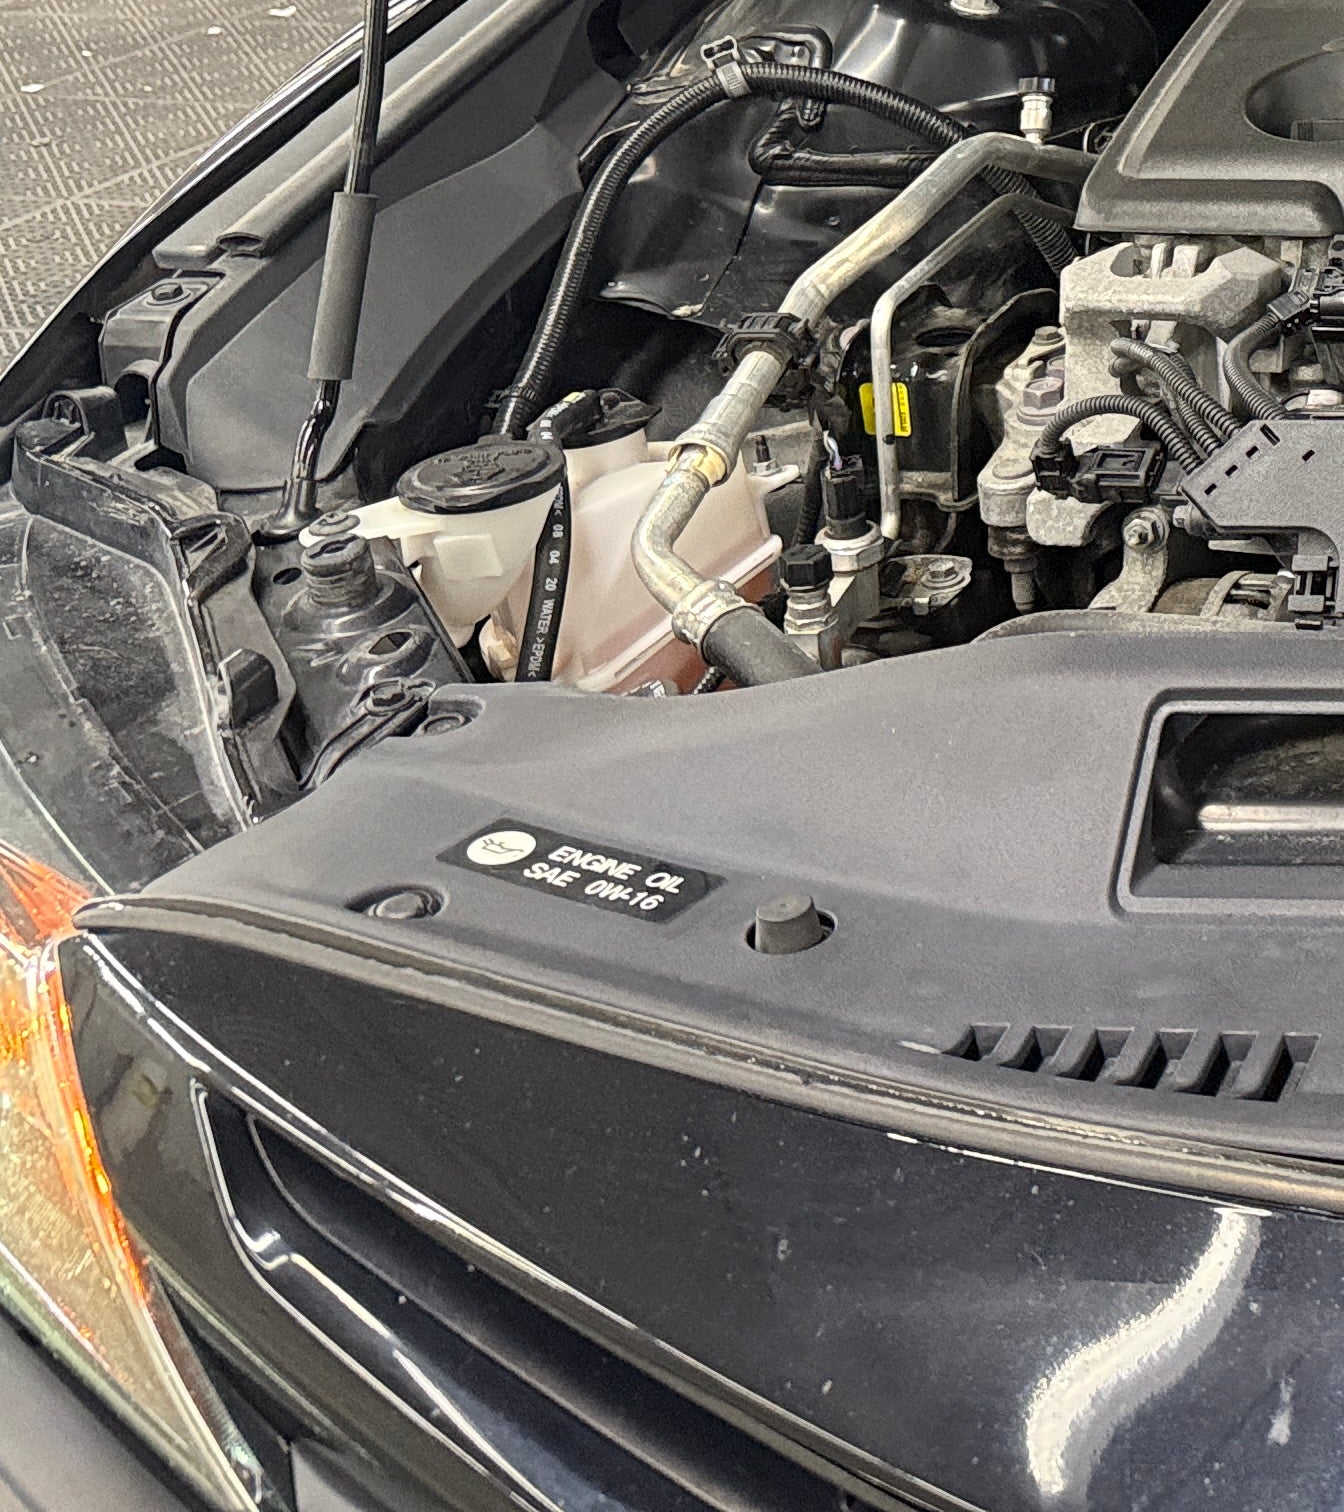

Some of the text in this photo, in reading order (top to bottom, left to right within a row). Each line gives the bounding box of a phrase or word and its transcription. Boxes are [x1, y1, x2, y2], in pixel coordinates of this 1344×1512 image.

[544, 577, 558, 592] 20
[537, 598, 555, 635] WATER
[523, 862, 664, 910] SAE 0W-16
[548, 845, 685, 894] ENGINE OIL
